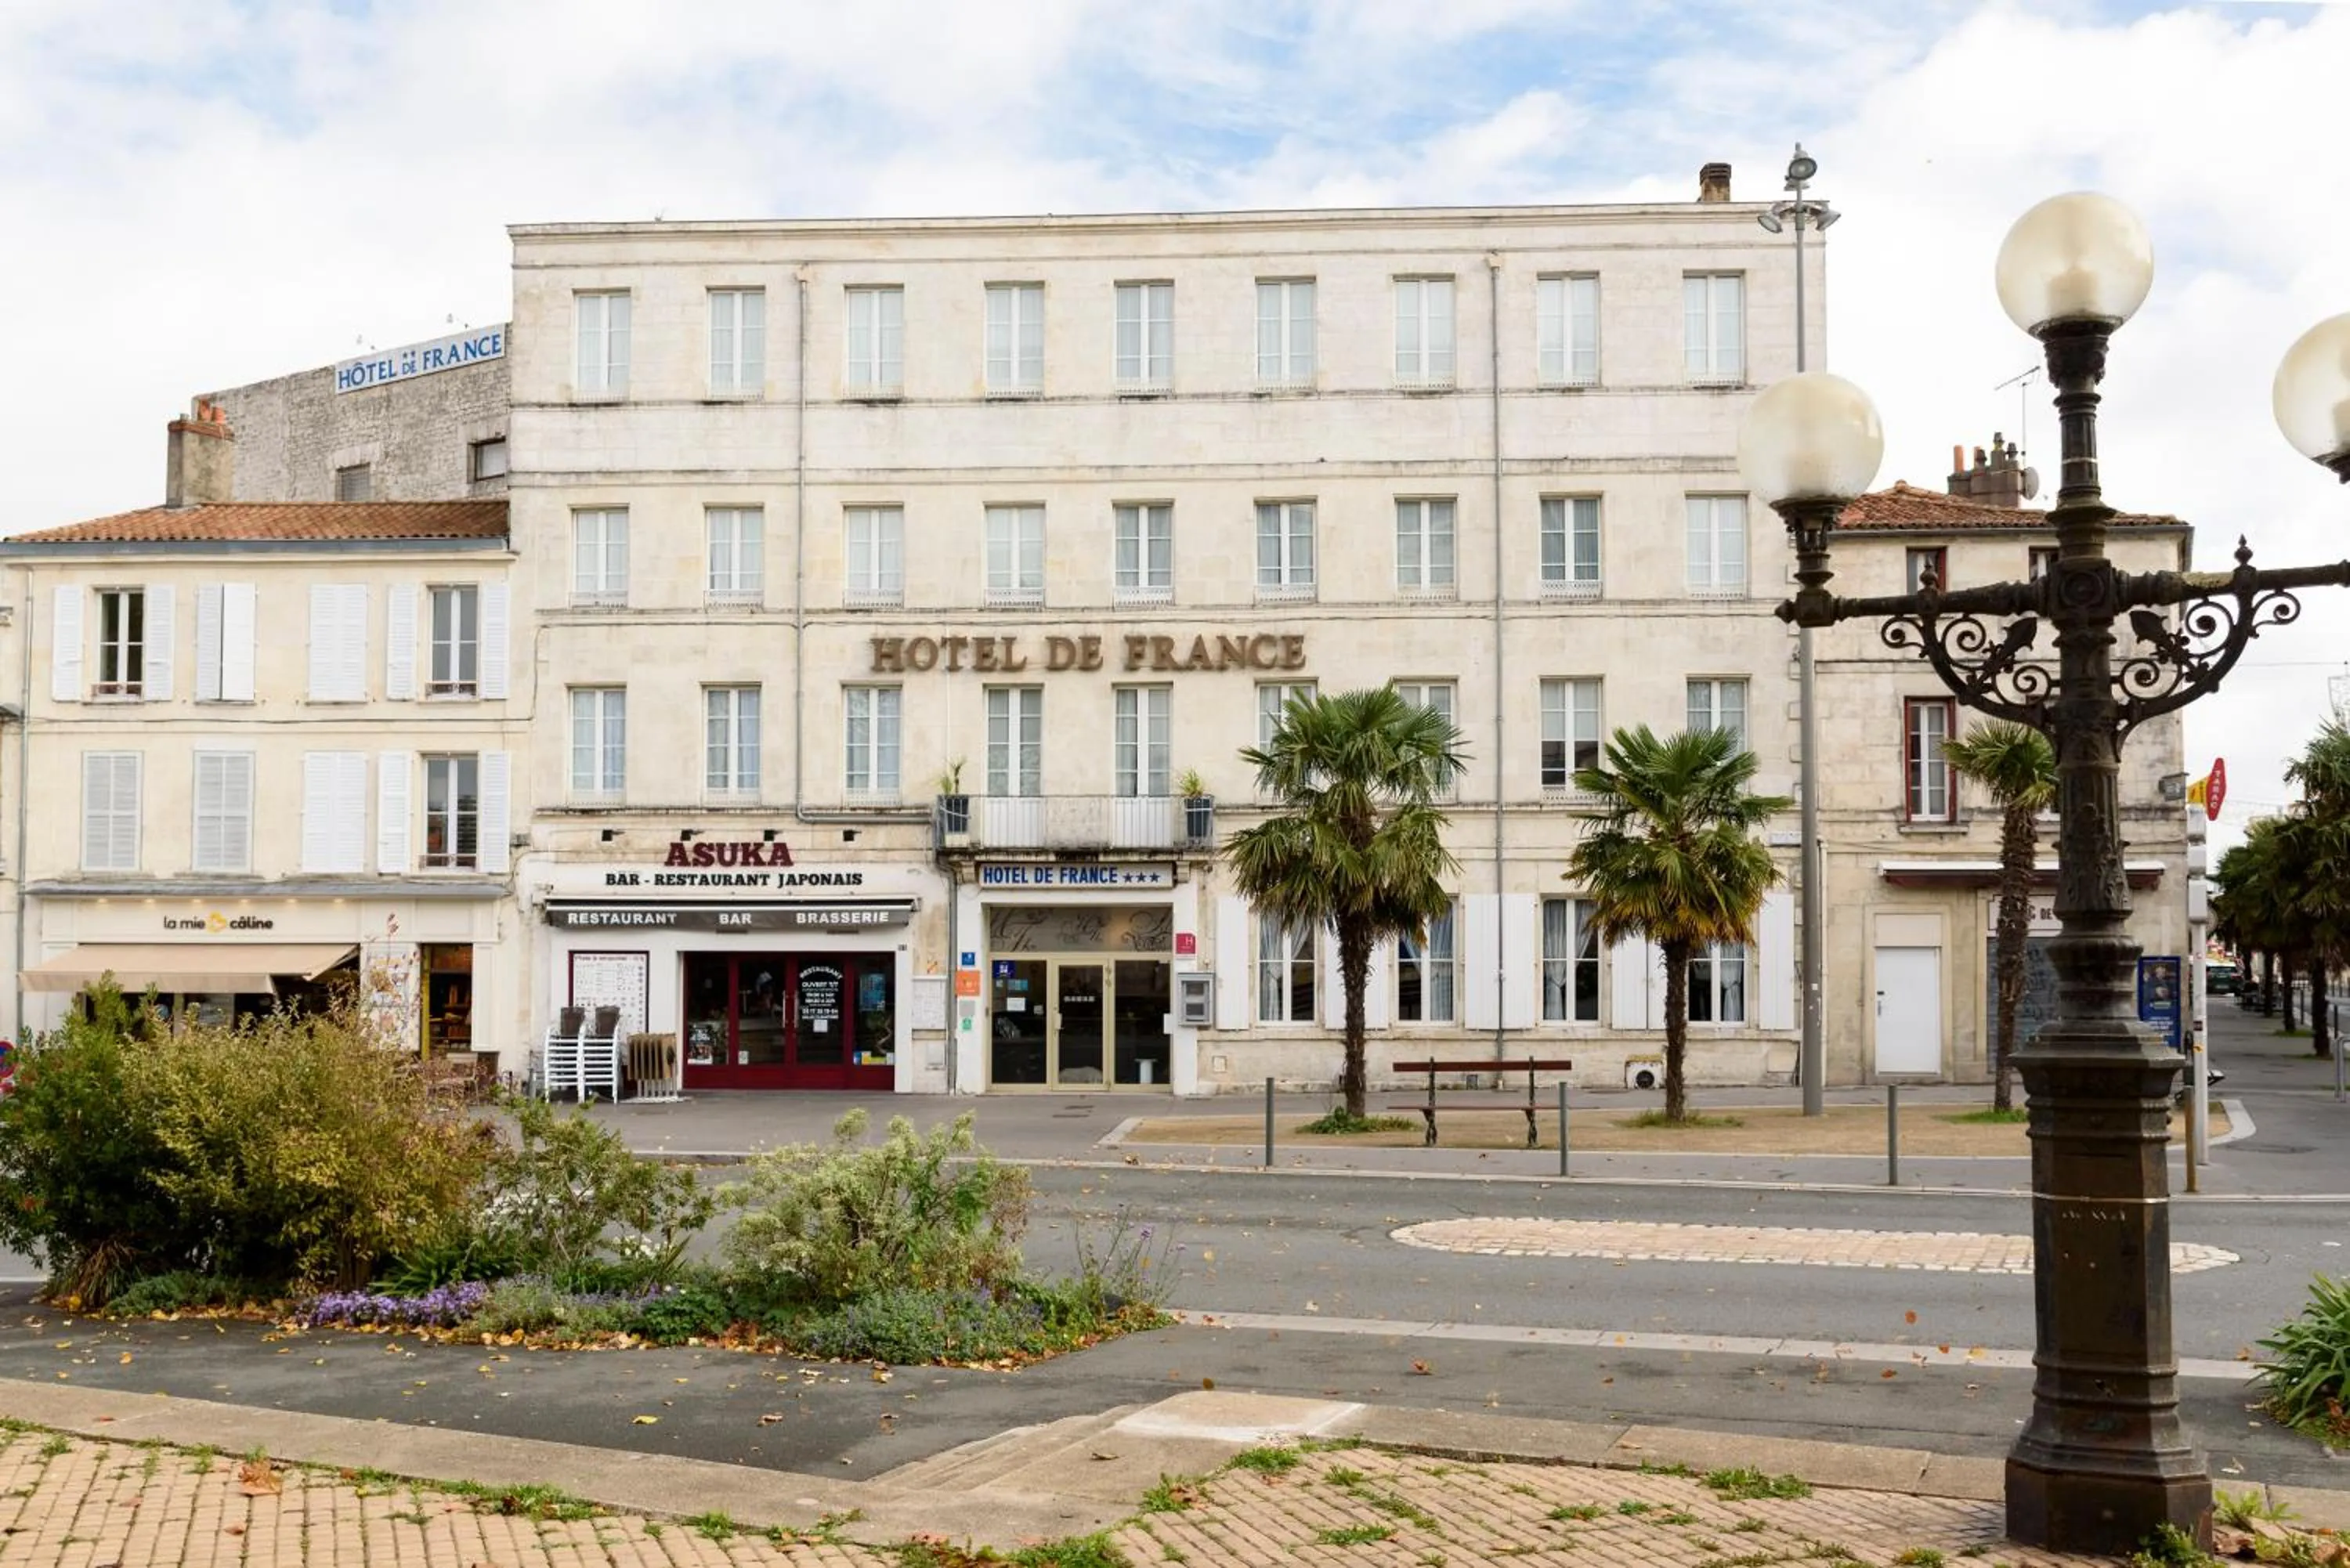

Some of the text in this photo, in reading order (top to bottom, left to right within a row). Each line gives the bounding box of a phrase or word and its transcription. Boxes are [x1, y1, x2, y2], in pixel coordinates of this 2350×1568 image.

[338, 334, 502, 390] HÔTEL DE FRANCE
[870, 634, 1307, 672] HOTEL DE FRANCE
[663, 842, 795, 867] ASUKA
[606, 873, 640, 886] BAR
[654, 873, 770, 886] RESTAURANT
[777, 873, 863, 889] JAPONAIS
[983, 866, 1119, 883] HOTEL DE FRANCE
[163, 915, 273, 930] la mie câline
[567, 912, 678, 925] RESTAURANT
[718, 912, 752, 925] BAR
[795, 911, 890, 923] BRASSERIE
[799, 966, 844, 980] RESTAURANT
